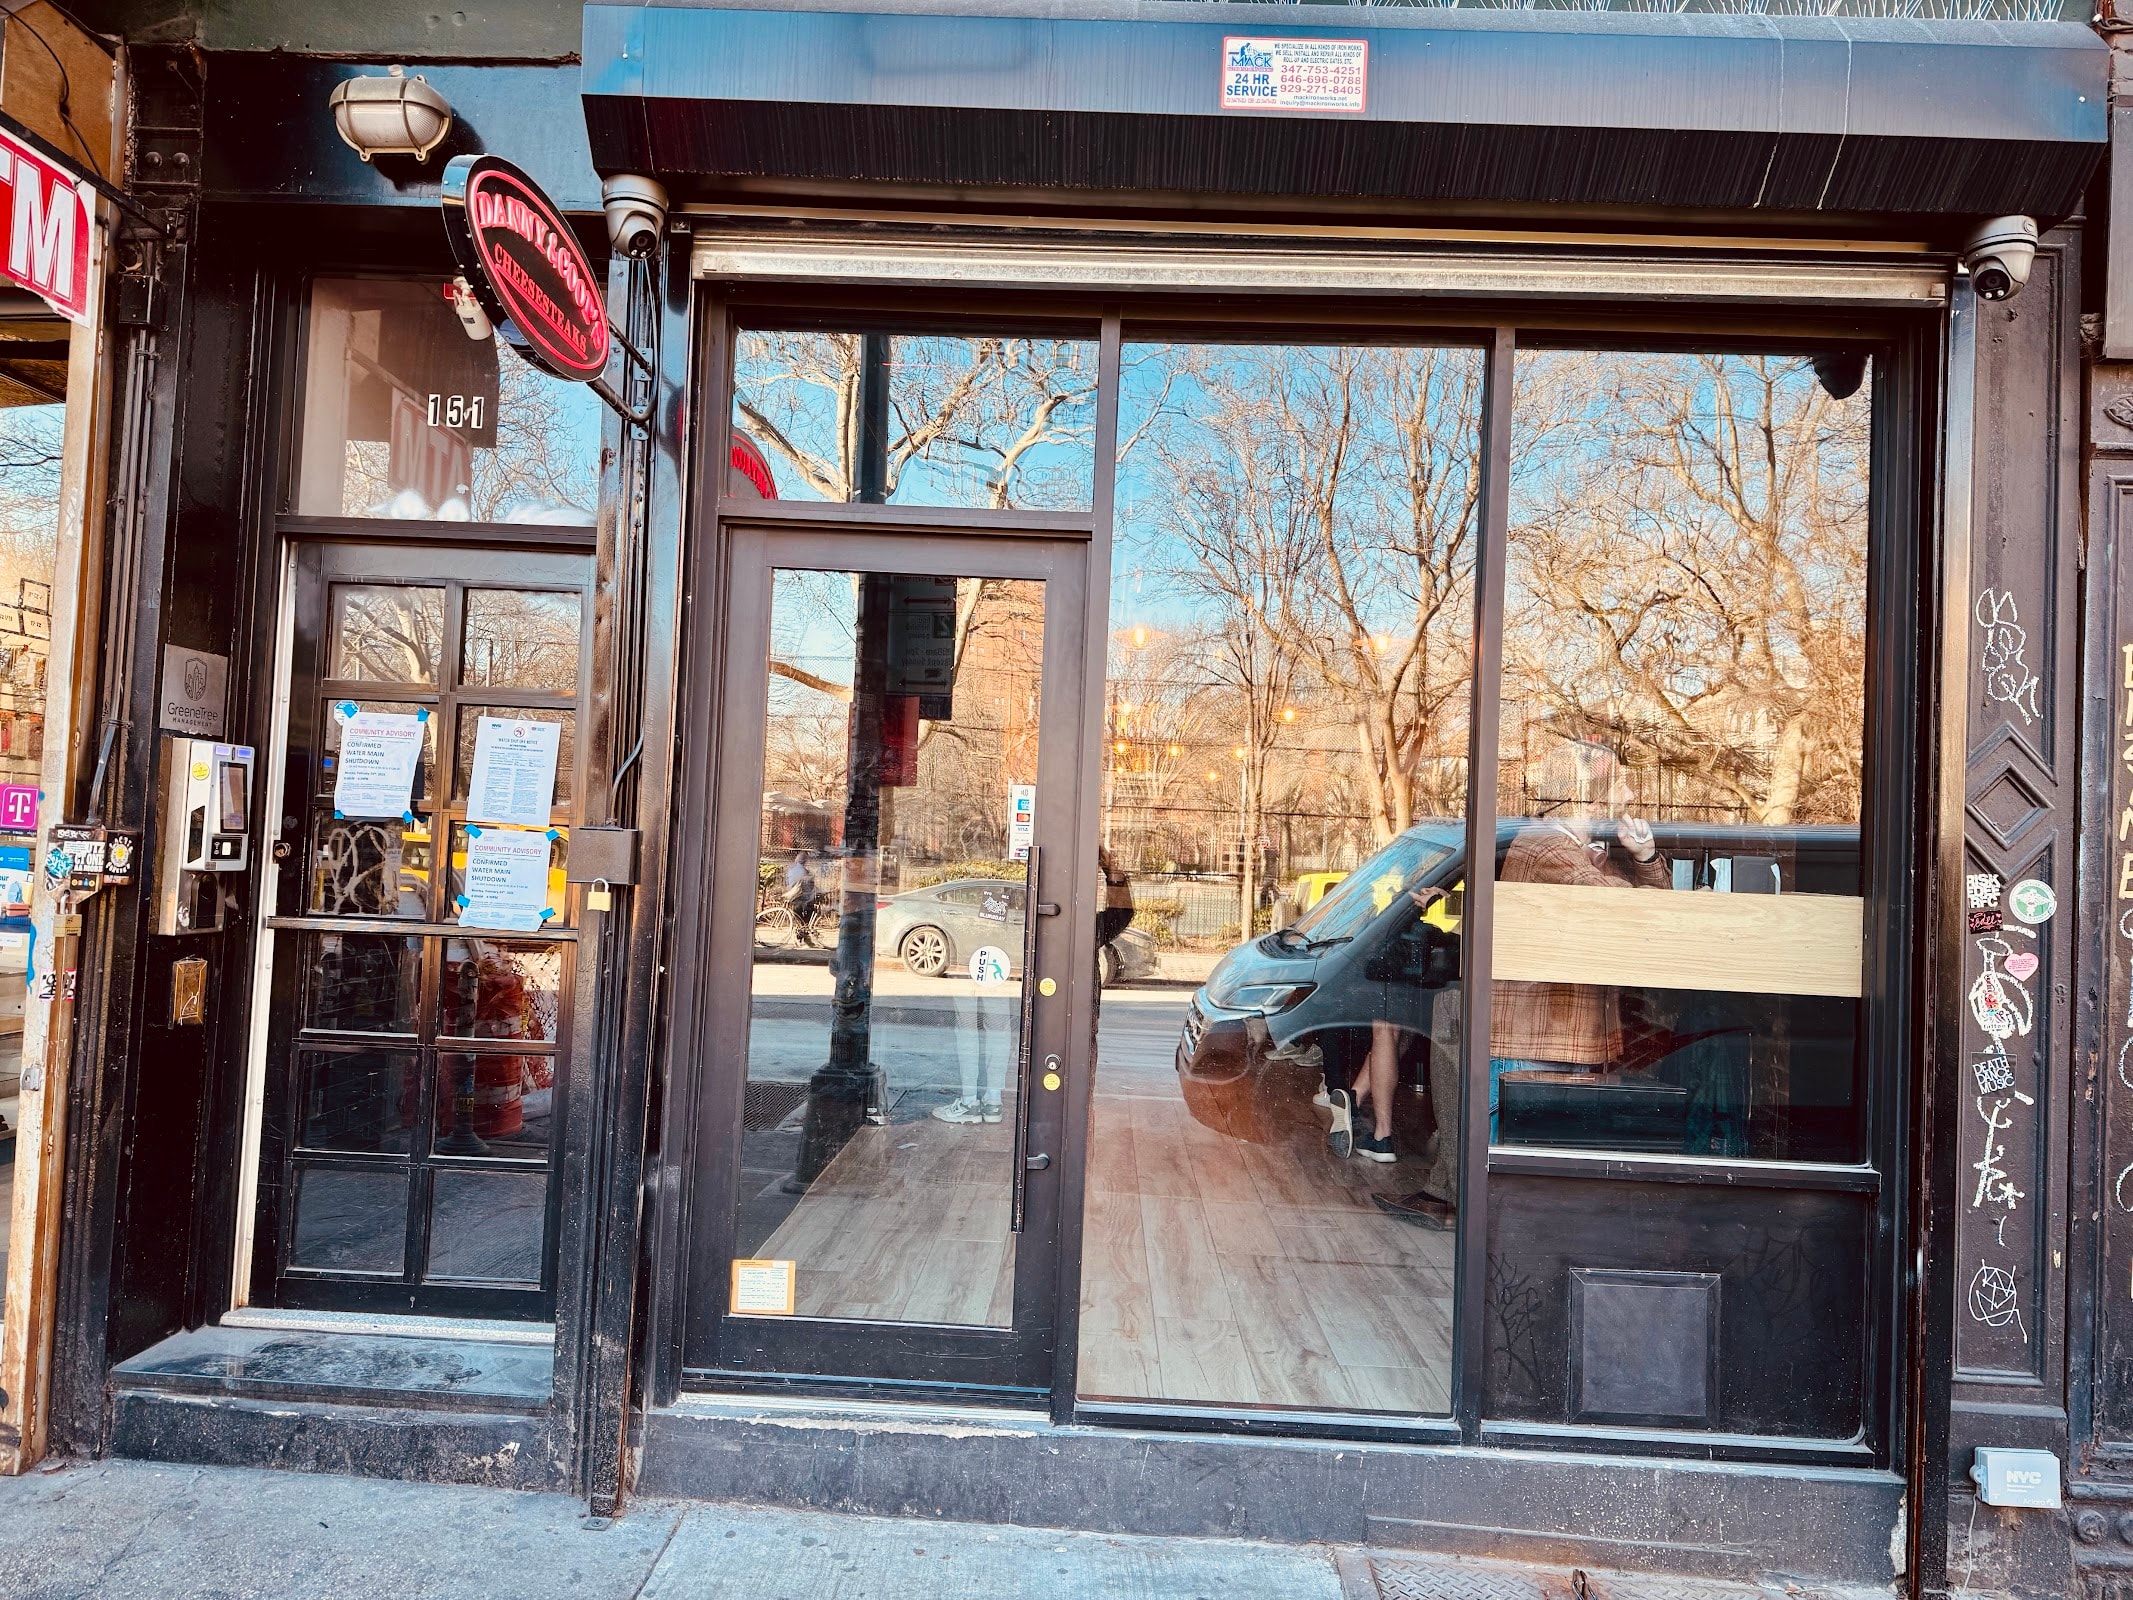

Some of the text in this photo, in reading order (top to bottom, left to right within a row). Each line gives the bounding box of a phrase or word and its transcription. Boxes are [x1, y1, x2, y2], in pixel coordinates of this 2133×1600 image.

[1231, 57, 1272, 68] MACK
[1281, 65, 1361, 76] 347-753-4251
[1235, 73, 1269, 85] 24 HR
[1280, 74, 1361, 85] 646-696-0788
[1226, 85, 1278, 97] SERVICE
[1280, 84, 1361, 95] 929-271-8405
[0, 143, 77, 303] M
[475, 190, 605, 351] DANNY & COOP'S
[493, 242, 588, 353] CHEESESTEAKS
[428, 394, 484, 429] 151
[168, 702, 218, 721] GreeneTree
[172, 717, 212, 727] MANAGEMENT
[350, 728, 416, 738] COMMUNITY ADVISORY
[347, 741, 382, 749] CONFIRMED
[474, 845, 542, 855] COMMUNITY ADVISORY
[472, 858, 508, 866] CONFIRMED
[471, 875, 507, 883] SHUTDOWN
[976, 950, 987, 981] PUSH
[1973, 1056, 2010, 1075] DEATH
[1976, 1068, 2013, 1084] DANCE
[1980, 1076, 2015, 1095] MUSIC
[2006, 1470, 2041, 1485] NYC
